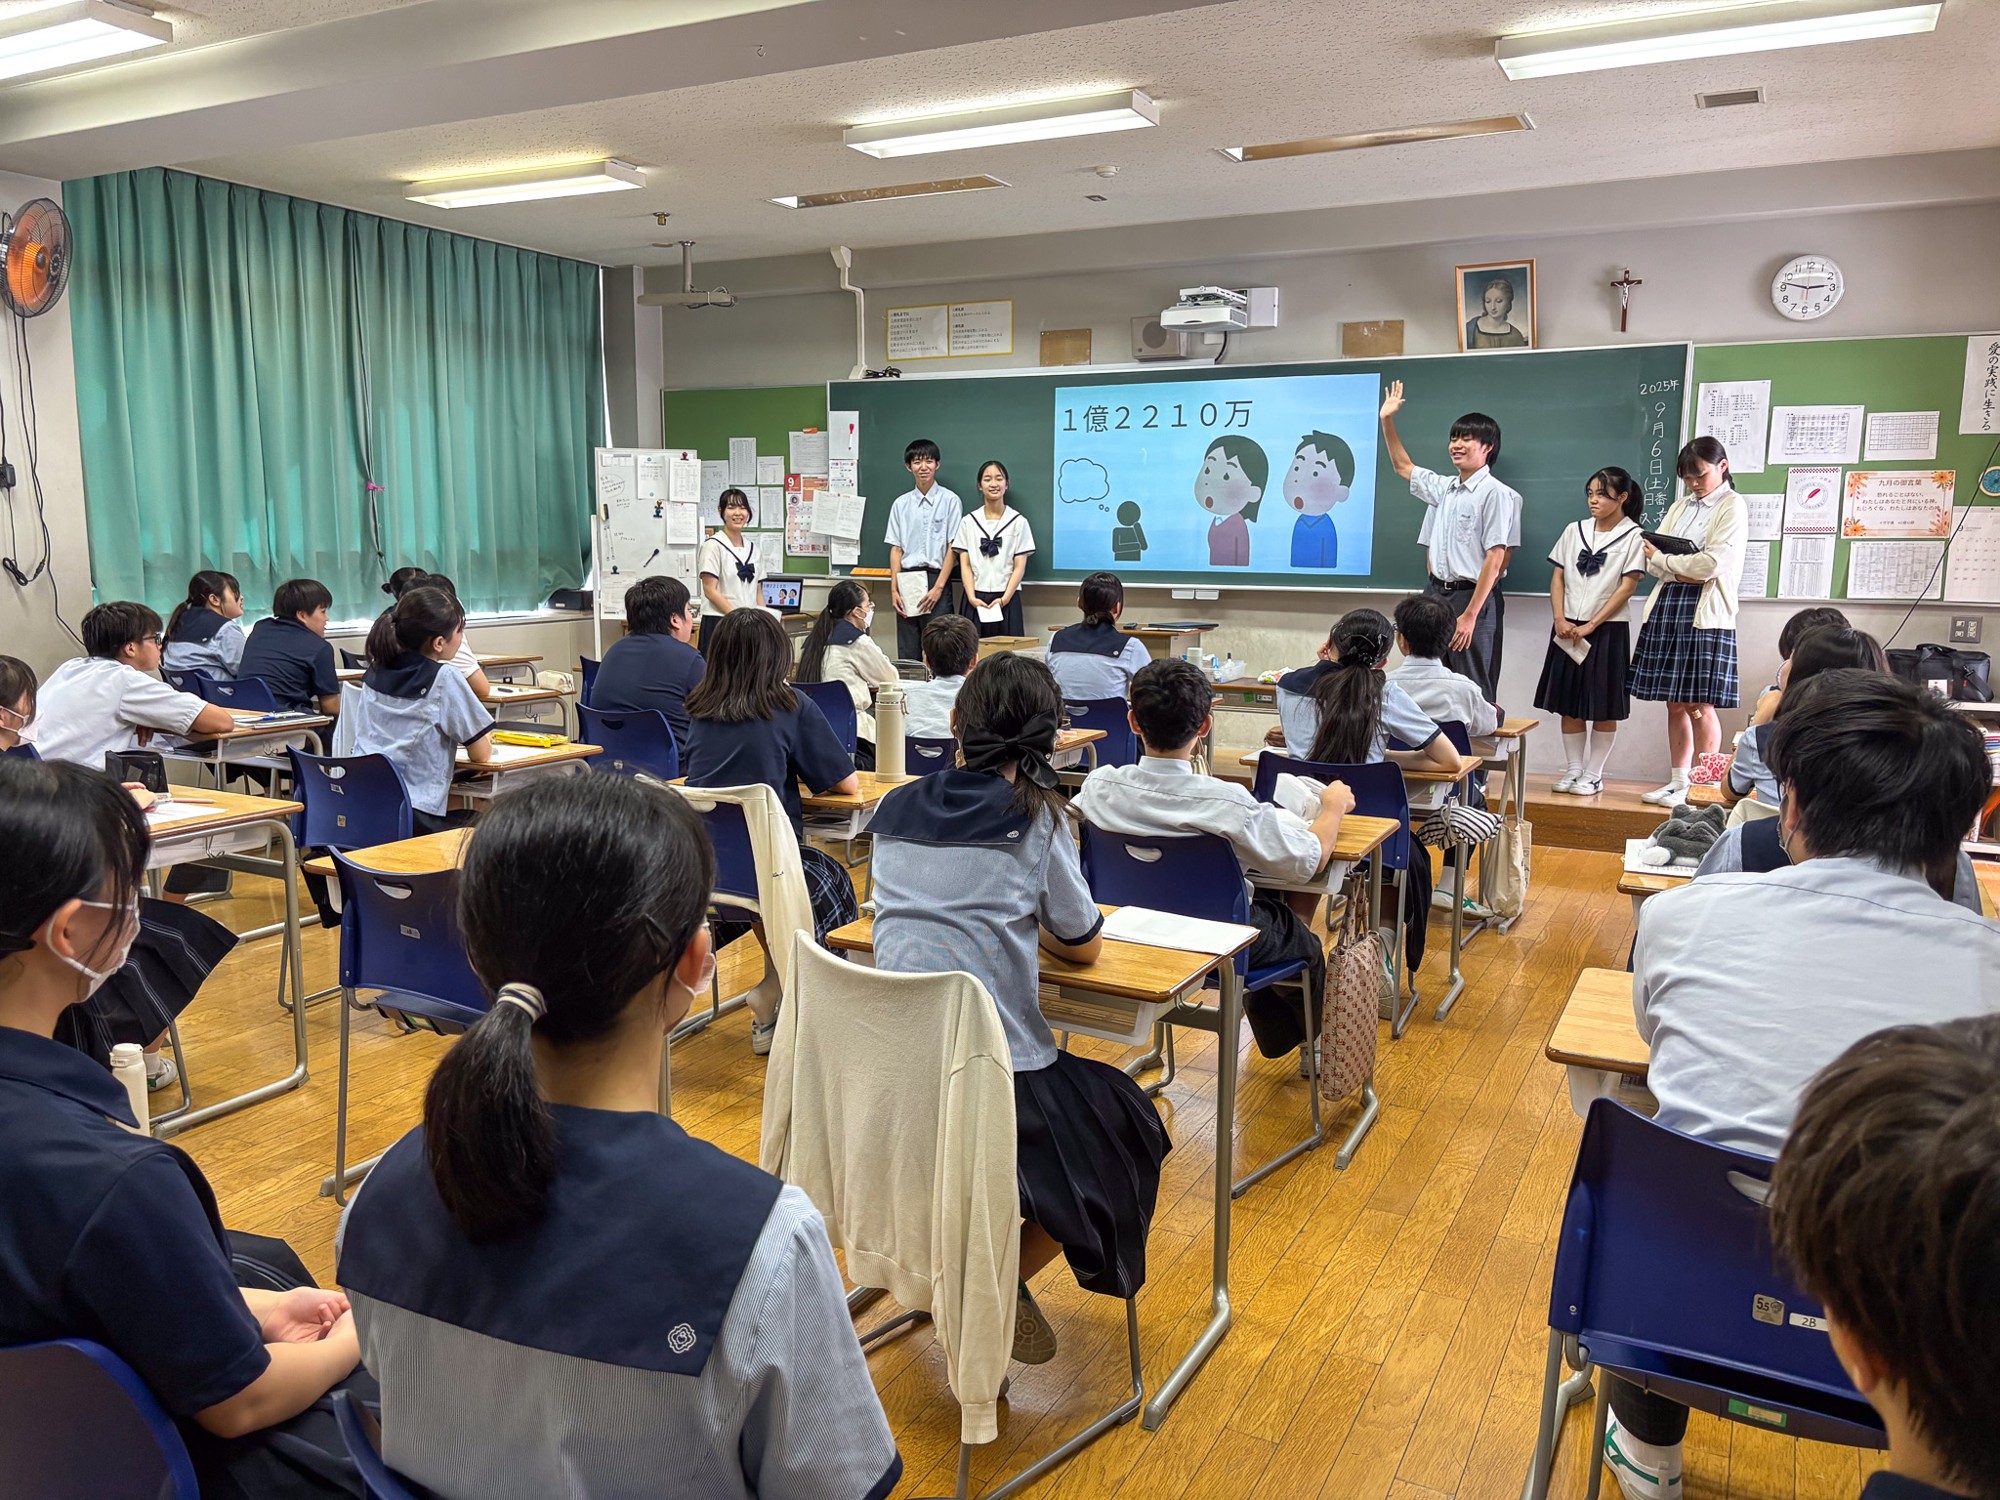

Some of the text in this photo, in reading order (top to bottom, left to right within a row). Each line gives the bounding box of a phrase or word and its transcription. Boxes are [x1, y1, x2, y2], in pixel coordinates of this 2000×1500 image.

[1795, 264, 1801, 272] 11
[1785, 272, 1793, 281] 10
[1827, 272, 1833, 280] 2
[1780, 283, 1787, 292] 9
[1829, 283, 1836, 292] 3
[1782, 295, 1789, 303] 8
[1823, 294, 1830, 302] 4
[1791, 303, 1797, 311] 7
[1801, 306, 1808, 314] 6
[1814, 303, 1820, 311] 5
[1640, 379, 1680, 395] 2025年
[1982, 341, 2000, 431] 愛の実践に生きる
[1063, 400, 1253, 433] 1億2210万
[788, 477, 795, 487] 9
[1801, 1317, 1817, 1328] 2B
